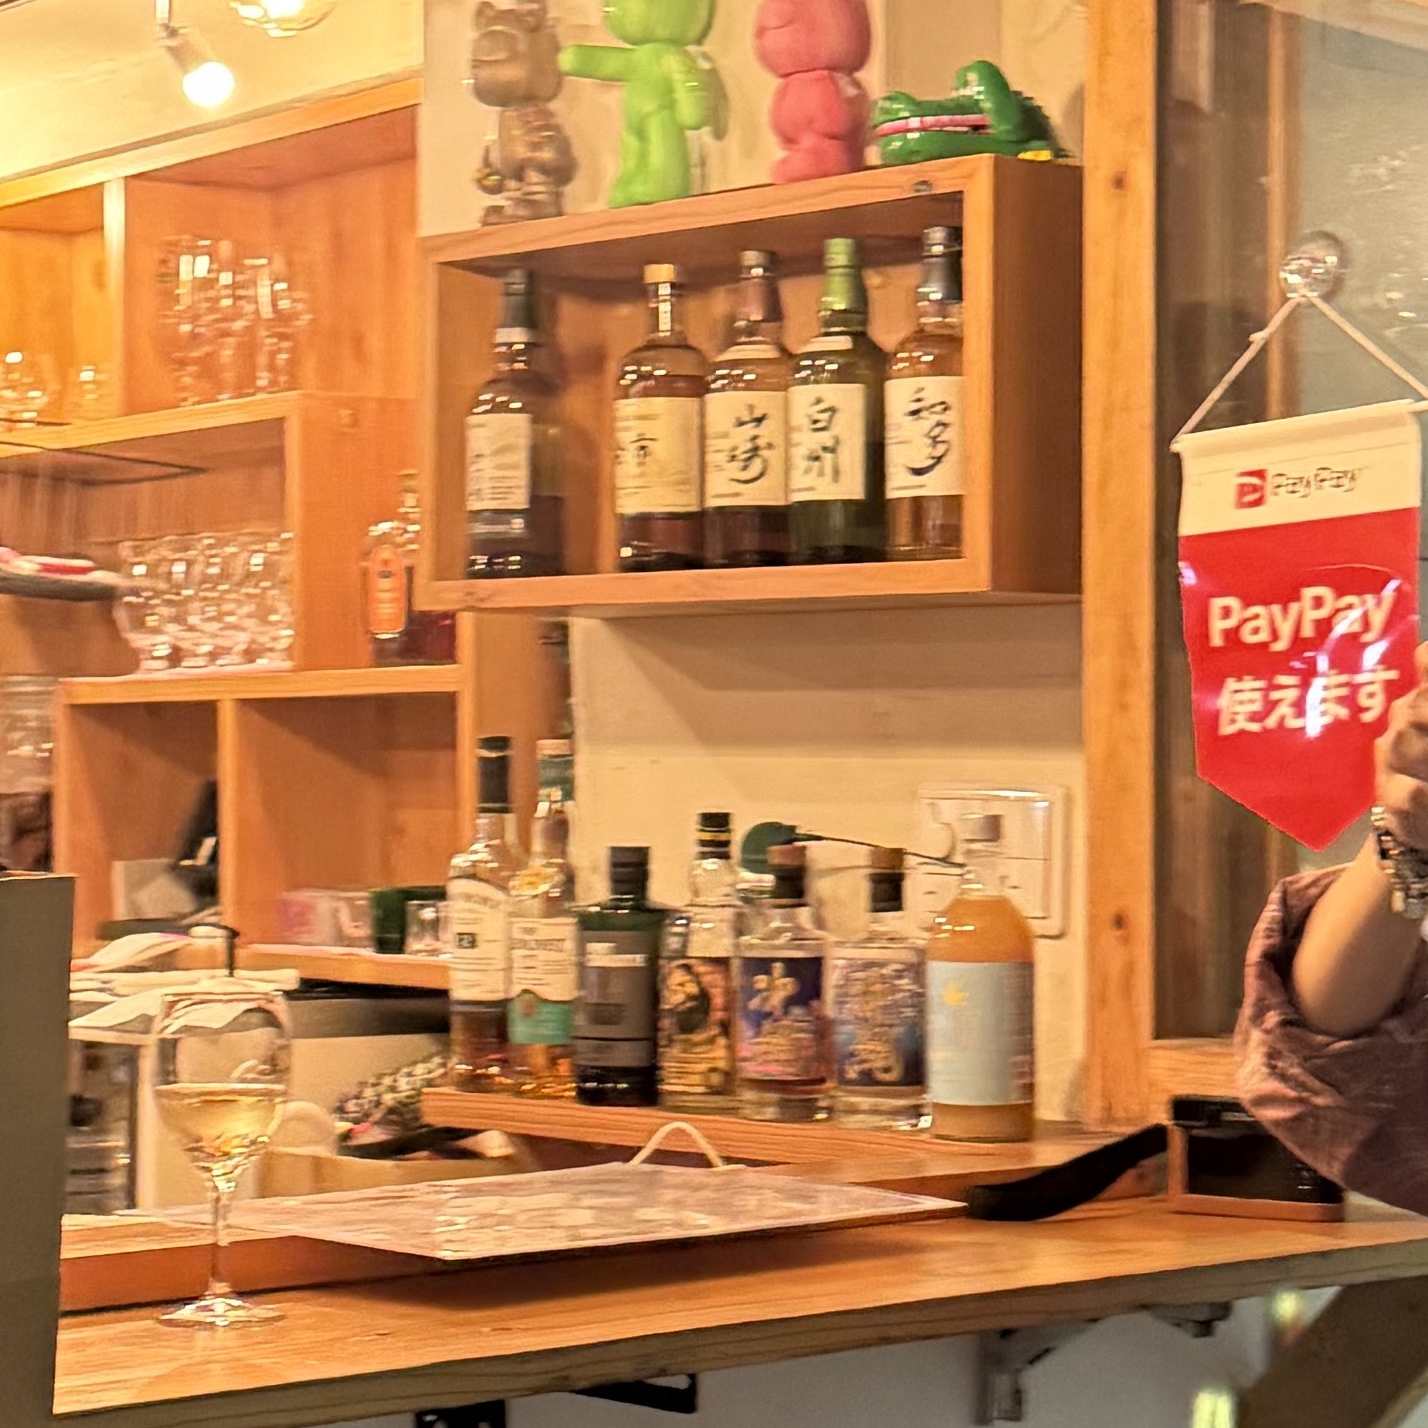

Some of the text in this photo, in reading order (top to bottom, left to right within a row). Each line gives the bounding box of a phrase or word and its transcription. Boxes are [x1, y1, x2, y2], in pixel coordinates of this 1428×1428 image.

[802, 396, 840, 484] 白州
[1272, 465, 1361, 499] PayPay
[1208, 585, 1396, 652] PayPay
[1217, 664, 1400, 736] 使えます
